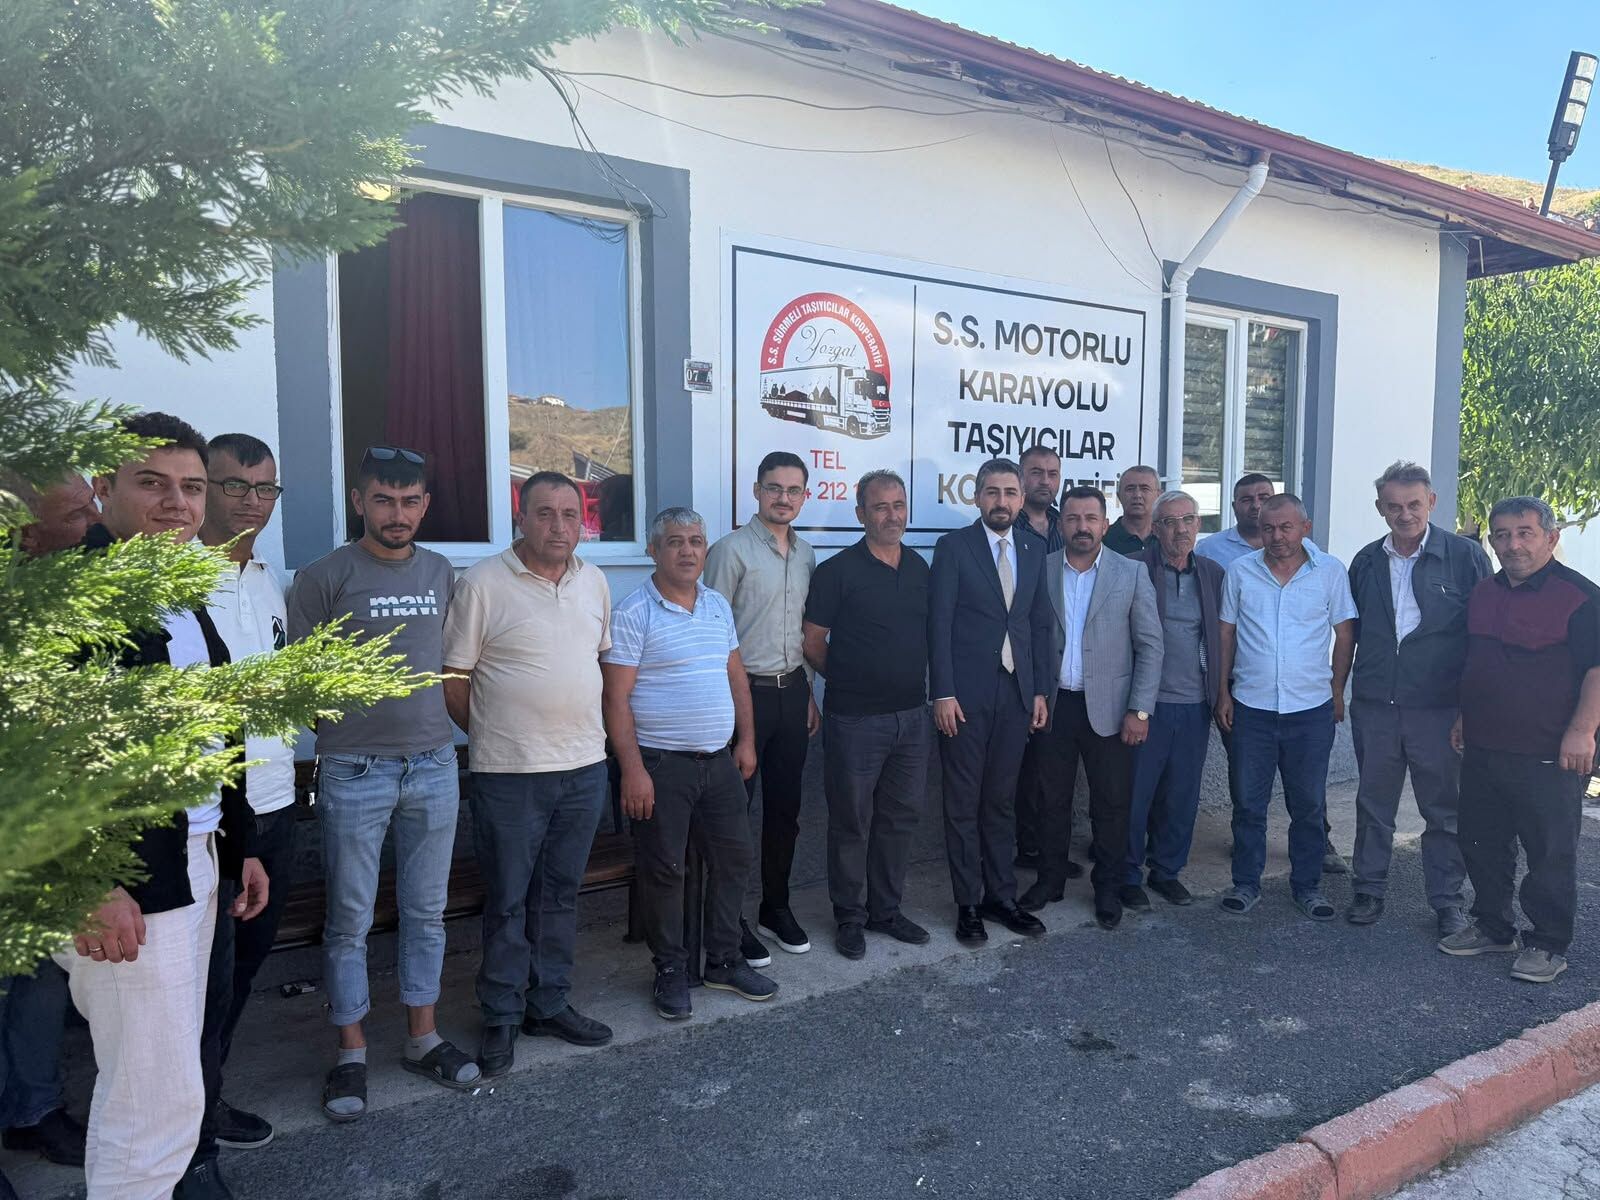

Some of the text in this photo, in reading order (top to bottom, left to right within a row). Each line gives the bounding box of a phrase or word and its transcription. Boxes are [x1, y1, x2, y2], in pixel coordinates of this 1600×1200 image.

[773, 306, 801, 344] SÜRMELİ
[801, 300, 850, 317] TAŞIYICILAR
[850, 312, 884, 368] KOOPERATİFİ
[795, 325, 857, 363] Yozgat
[933, 311, 1132, 366] S.S. MOTORLU
[959, 368, 1109, 413] KARAYOLU
[809, 449, 847, 470] TEL
[947, 420, 1116, 461] TAŞIYICILAR
[817, 481, 848, 501] 212
[369, 589, 439, 618] mavi
